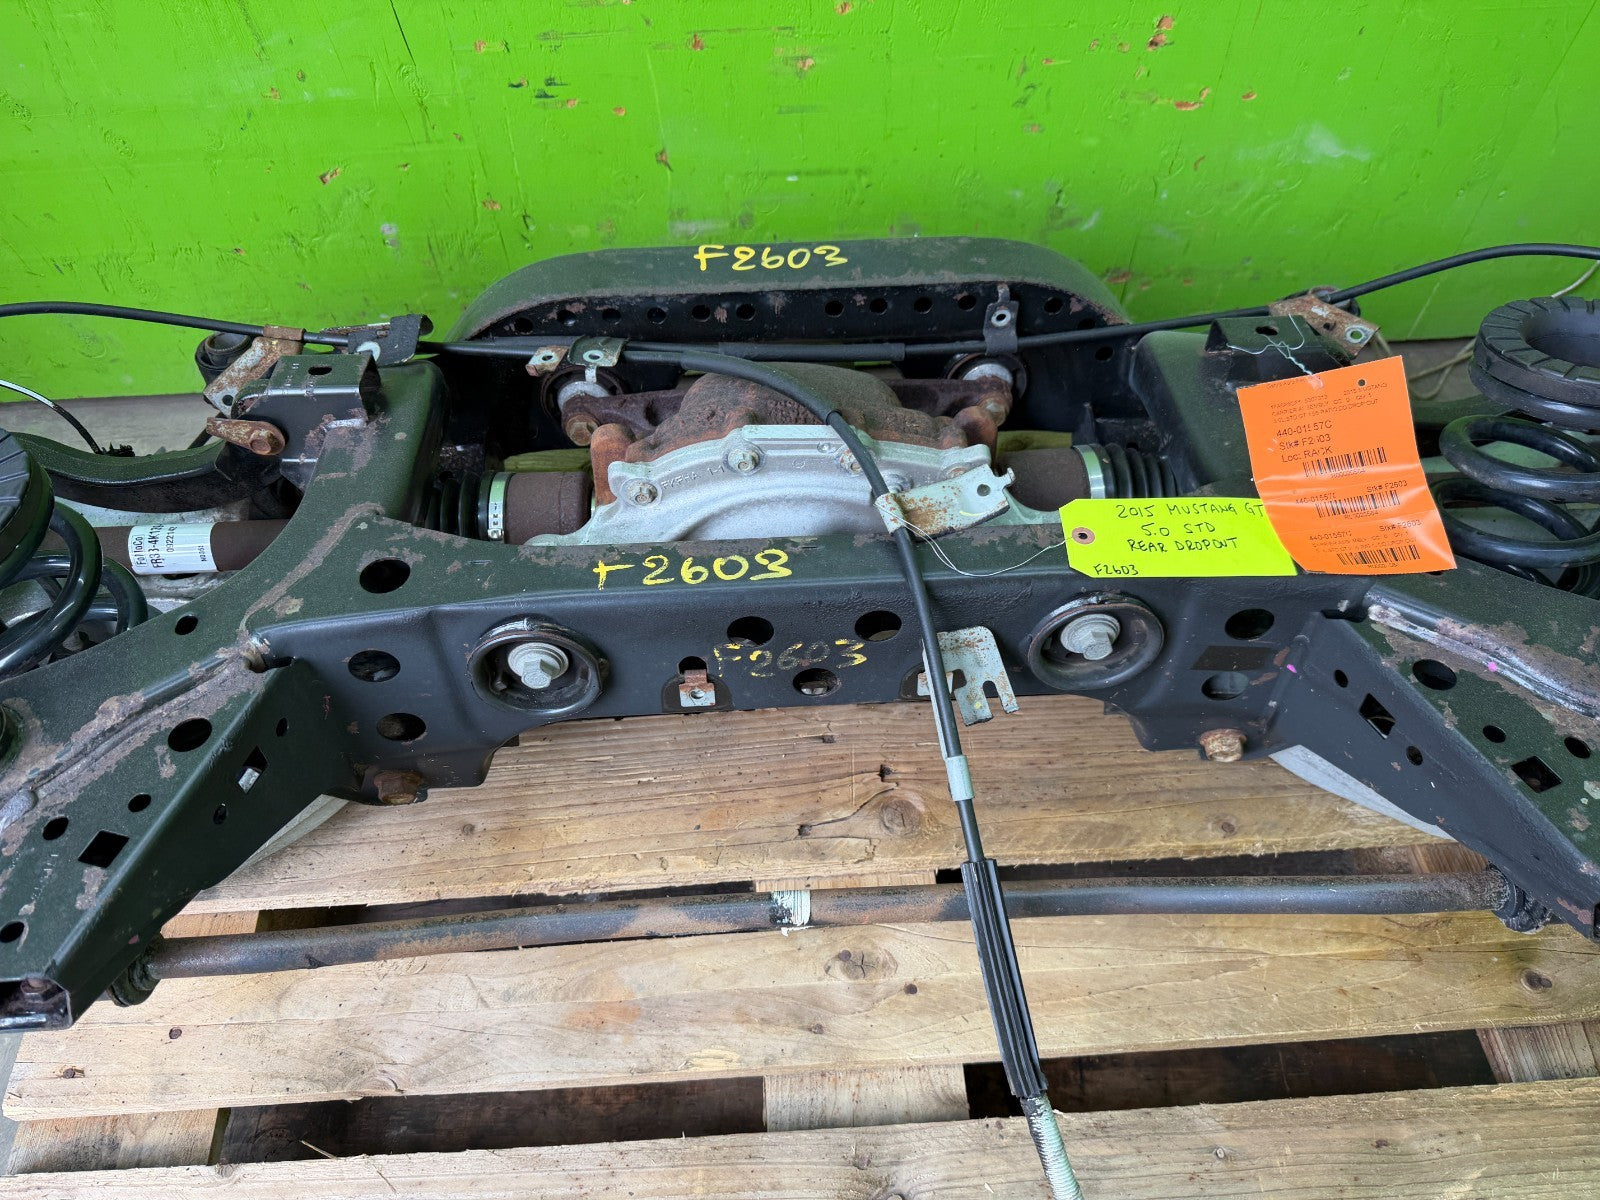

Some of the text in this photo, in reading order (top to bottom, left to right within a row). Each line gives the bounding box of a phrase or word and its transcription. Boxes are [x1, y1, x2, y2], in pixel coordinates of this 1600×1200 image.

[694, 244, 848, 271] F2603
[1115, 502, 1264, 519] 2015 MUSTANG GT
[1140, 521, 1216, 537] 5.0 STD
[1127, 537, 1238, 553] REAR DROPOUT
[1093, 564, 1139, 576] F2603
